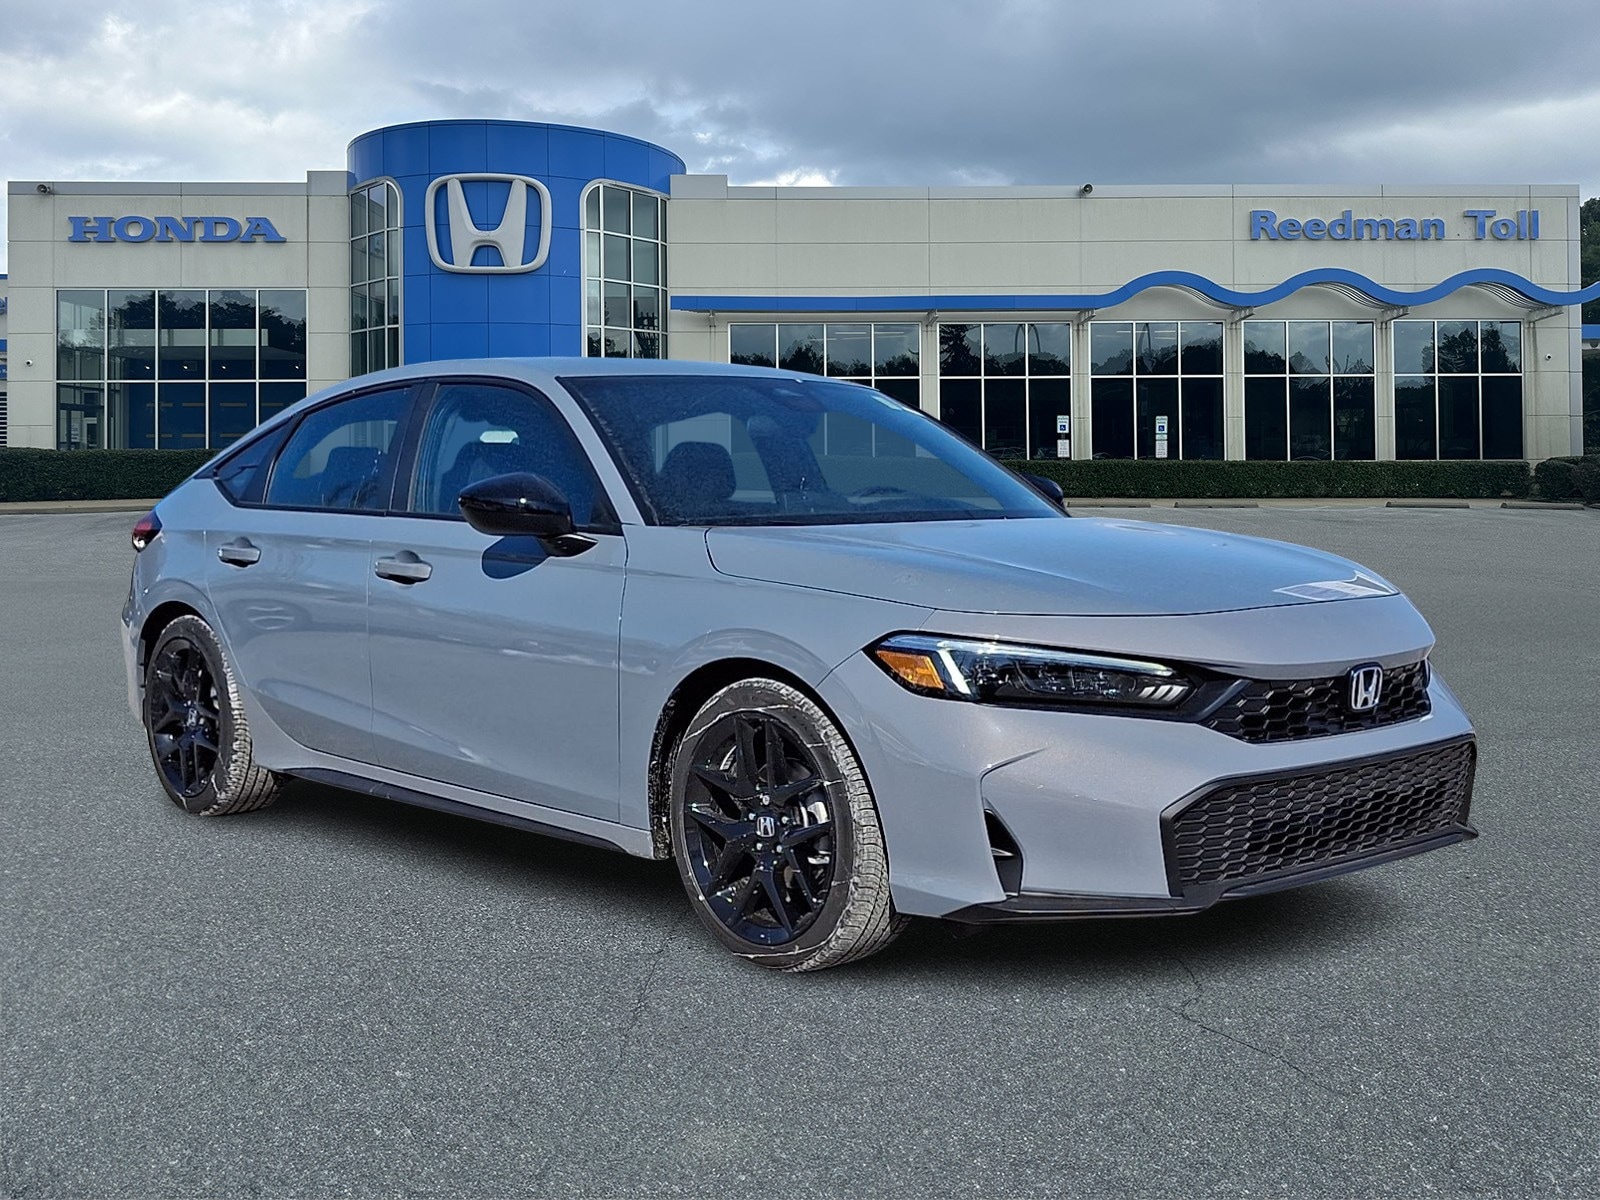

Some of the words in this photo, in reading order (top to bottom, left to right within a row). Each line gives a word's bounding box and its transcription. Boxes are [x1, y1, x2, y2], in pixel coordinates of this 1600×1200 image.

[68, 215, 287, 243] HONDA
[1250, 209, 1446, 241] Reedman
[1463, 209, 1540, 241] Toll
